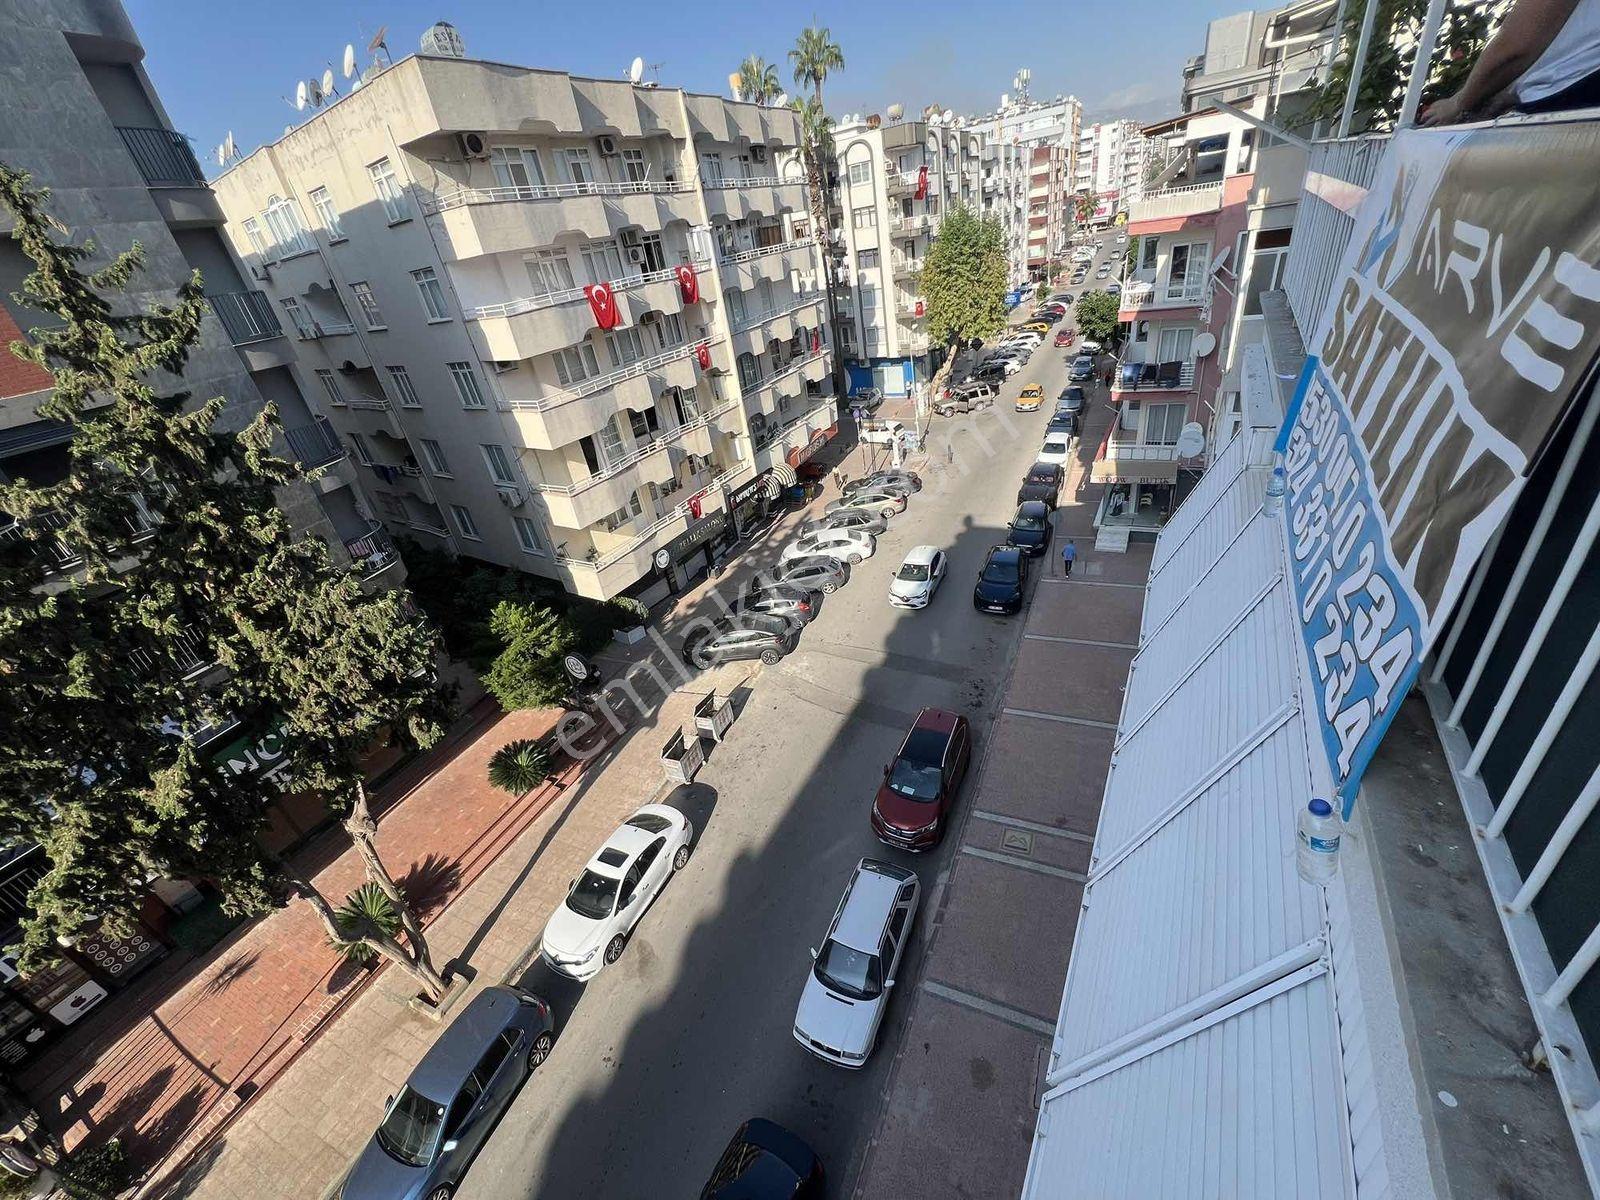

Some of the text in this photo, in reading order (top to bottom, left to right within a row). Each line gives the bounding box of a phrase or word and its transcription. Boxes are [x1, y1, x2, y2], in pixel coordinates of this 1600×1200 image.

[1285, 414, 1318, 507] 324
[1314, 604, 1371, 779] 234
[1320, 277, 1517, 626] SATILIK
[1337, 540, 1413, 715] 234
